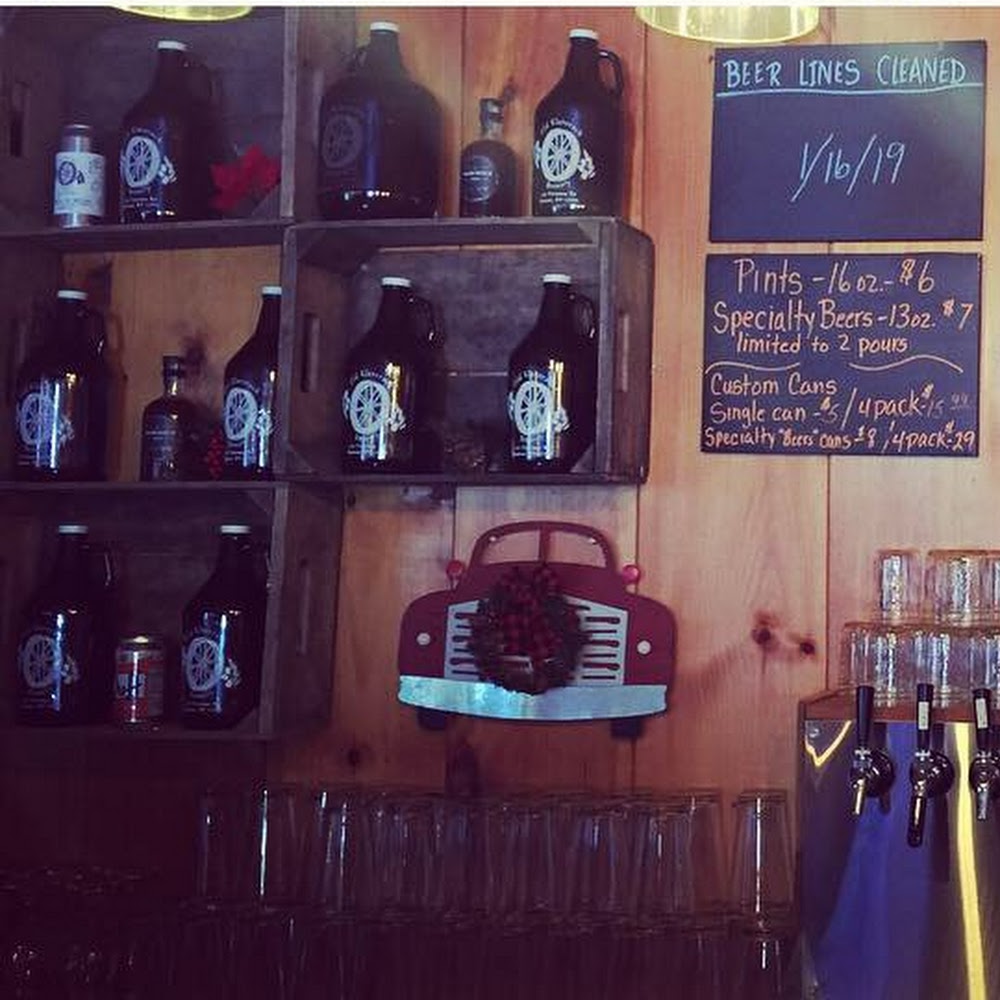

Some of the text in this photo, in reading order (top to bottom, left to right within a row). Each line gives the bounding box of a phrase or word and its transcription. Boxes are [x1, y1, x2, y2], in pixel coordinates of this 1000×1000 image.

[723, 55, 966, 88] BEER LINES CLEANED
[790, 133, 906, 202] 1/16/19
[733, 258, 803, 295] Pints
[713, 300, 815, 338] Specialty
[819, 299, 873, 330] Beers
[736, 334, 908, 358] limited to 2 pours
[710, 371, 838, 396] Custom Cans
[710, 402, 765, 428] Single
[772, 404, 806, 422] can
[704, 426, 775, 450] Specialty
